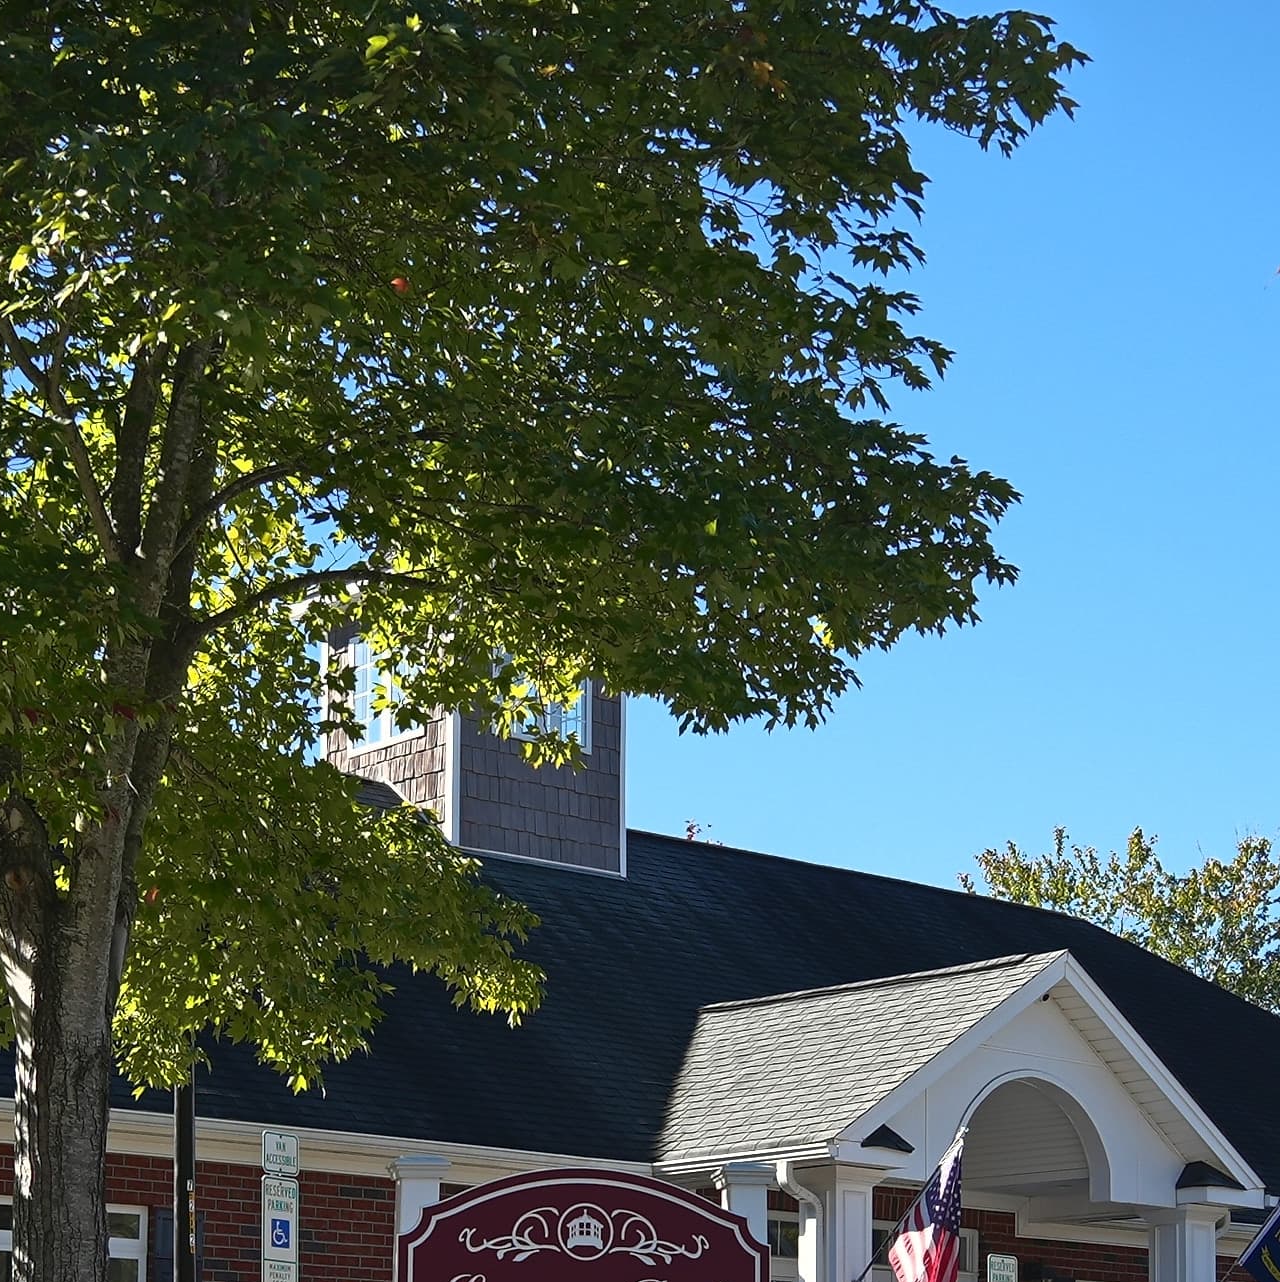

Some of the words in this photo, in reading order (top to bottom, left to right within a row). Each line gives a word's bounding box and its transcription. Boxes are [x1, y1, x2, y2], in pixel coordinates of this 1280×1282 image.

[275, 1141, 286, 1153] VAN
[266, 1153, 296, 1167] ACCESSIBLE
[266, 1184, 297, 1199] RESERVED
[267, 1199, 294, 1213] PARKING
[269, 1263, 291, 1271] MAXIMUM
[991, 1262, 1015, 1272] RESERVED
[269, 1271, 291, 1280] PENALTY
[992, 1272, 1013, 1282] PARKING
